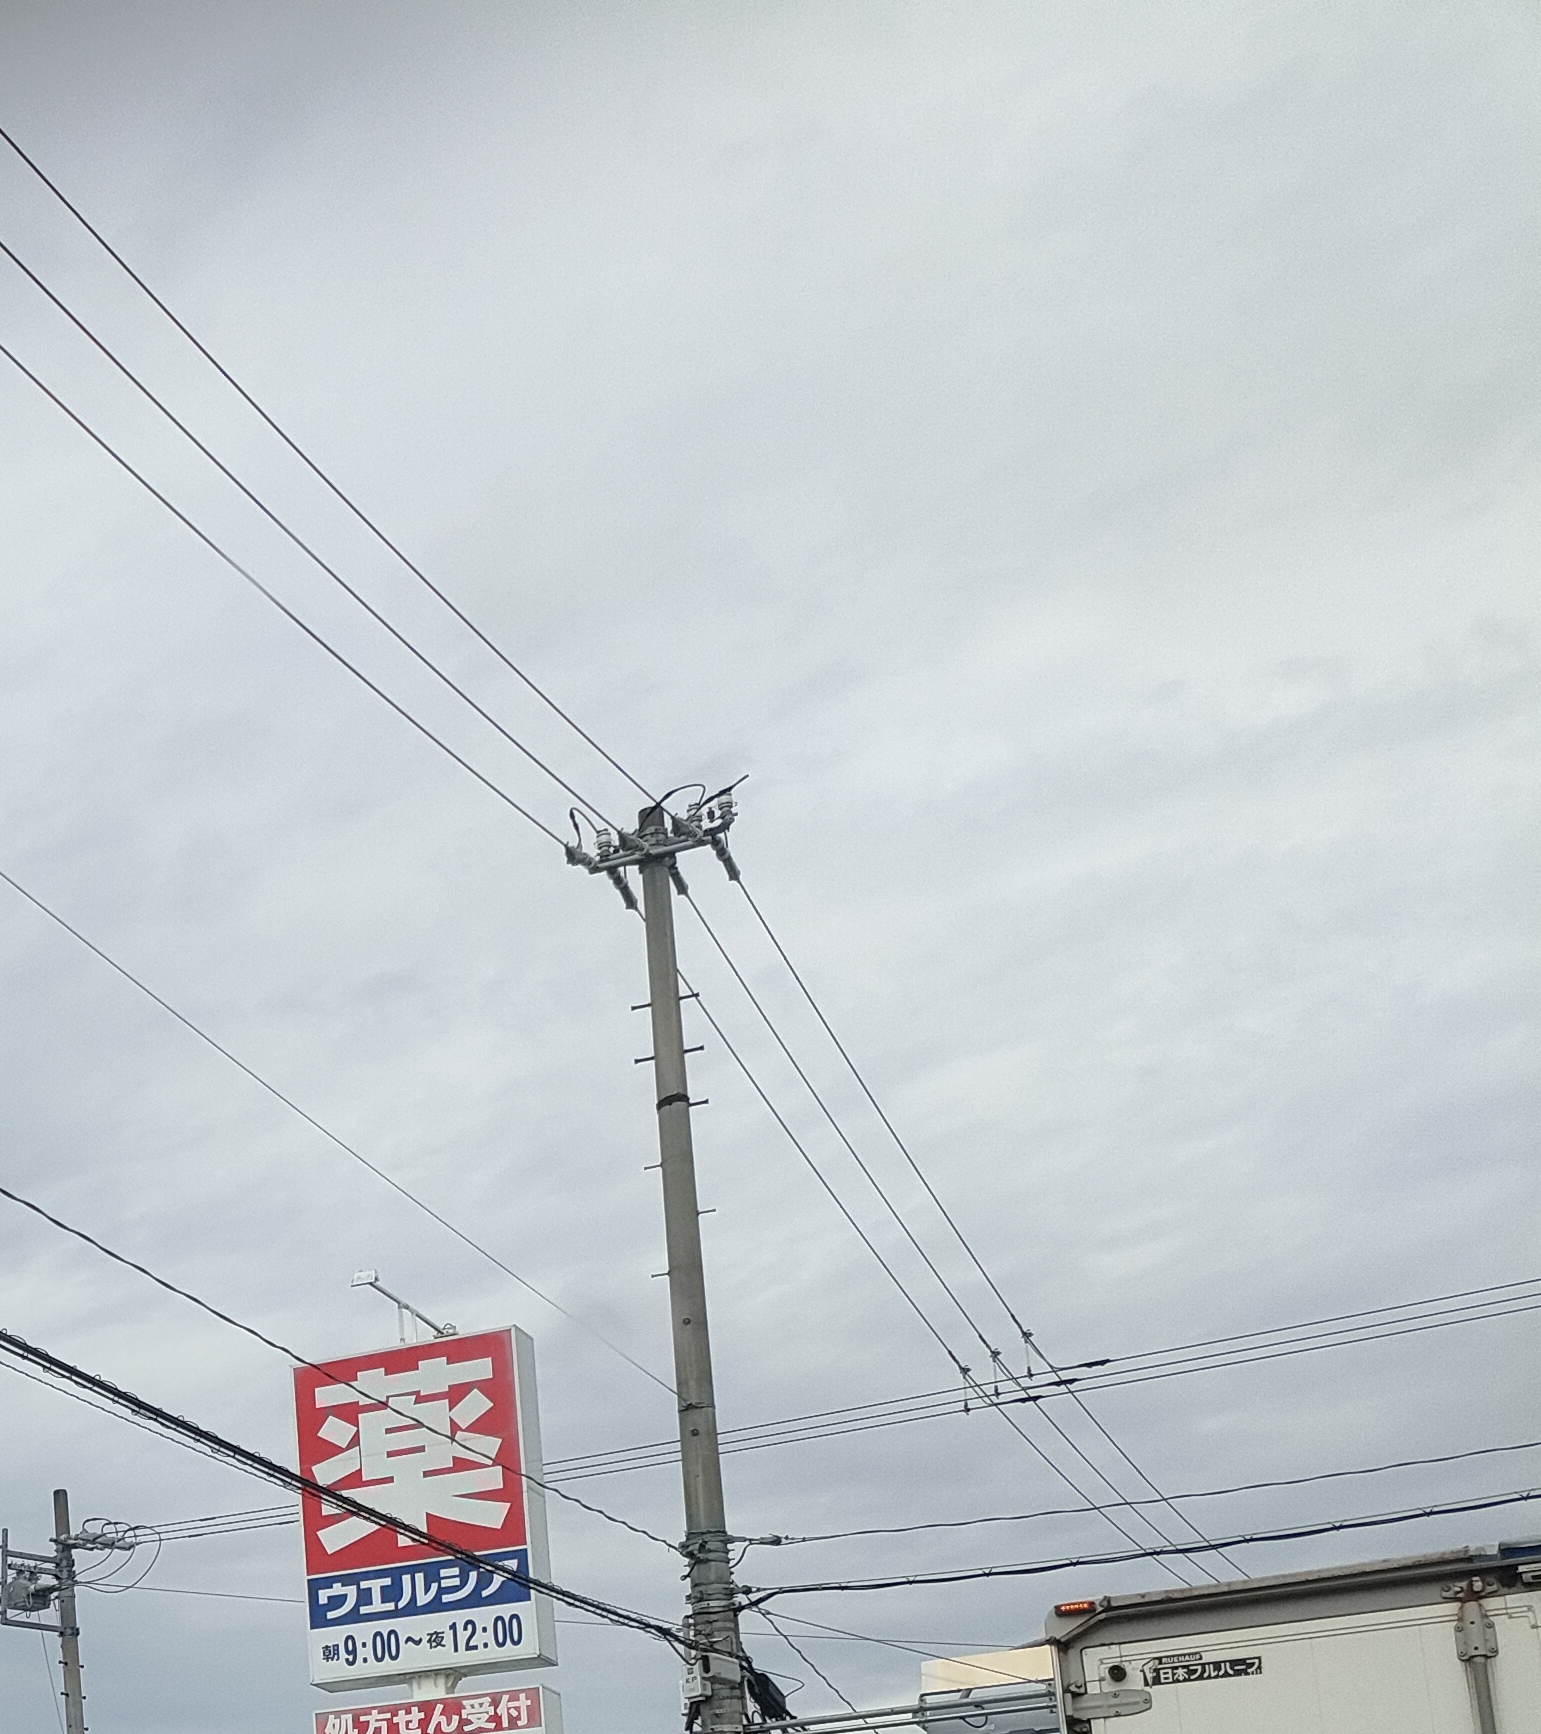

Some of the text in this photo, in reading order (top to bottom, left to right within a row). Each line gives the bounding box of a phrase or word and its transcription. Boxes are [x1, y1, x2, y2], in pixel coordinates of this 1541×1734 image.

[311, 1357, 511, 1555] 薬
[318, 1559, 519, 1621] ウエルシア
[1159, 1660, 1261, 1684] 日本フルハーフ
